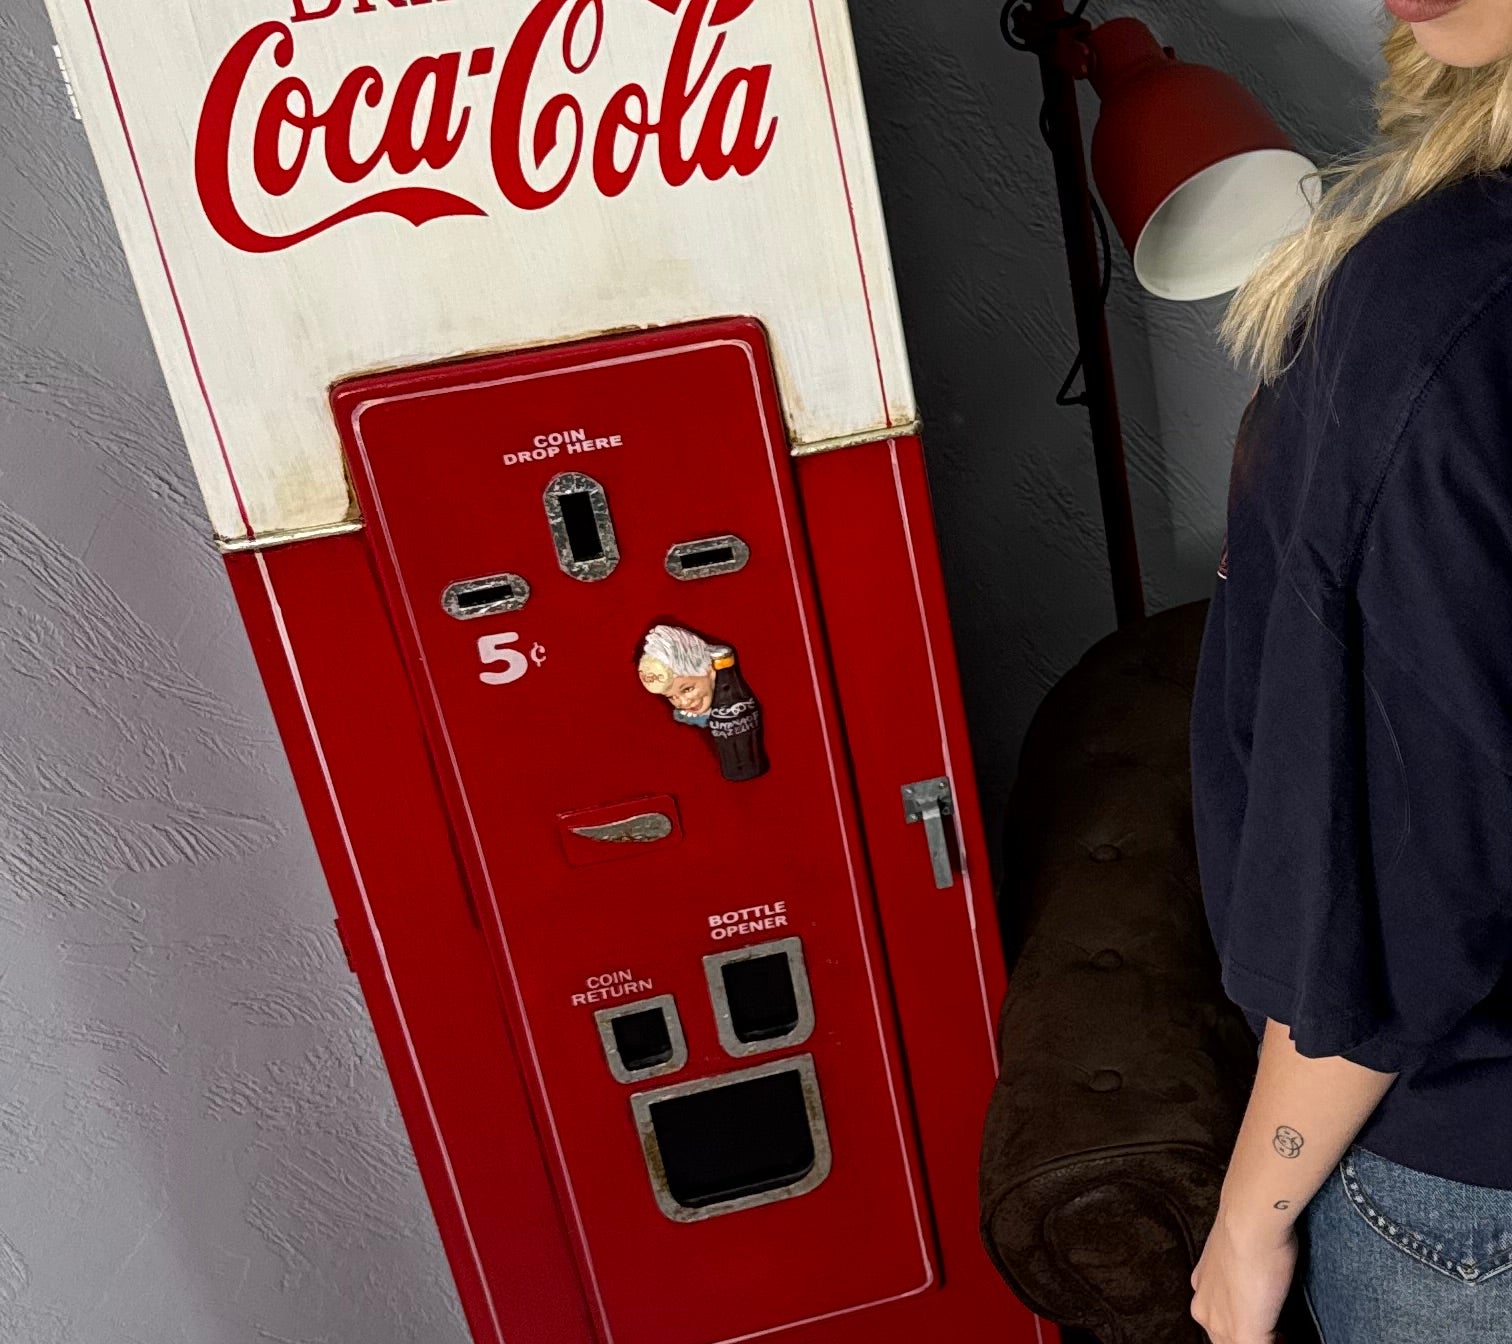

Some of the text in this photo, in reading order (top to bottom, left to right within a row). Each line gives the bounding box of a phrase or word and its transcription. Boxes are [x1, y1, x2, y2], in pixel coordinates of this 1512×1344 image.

[503, 434, 623, 466] DROP HERE
[533, 428, 586, 448] COIN
[707, 900, 786, 928] BOTTLE
[710, 915, 788, 941] OPENER
[571, 978, 653, 1007] RETURN
[586, 969, 632, 990] COIN
